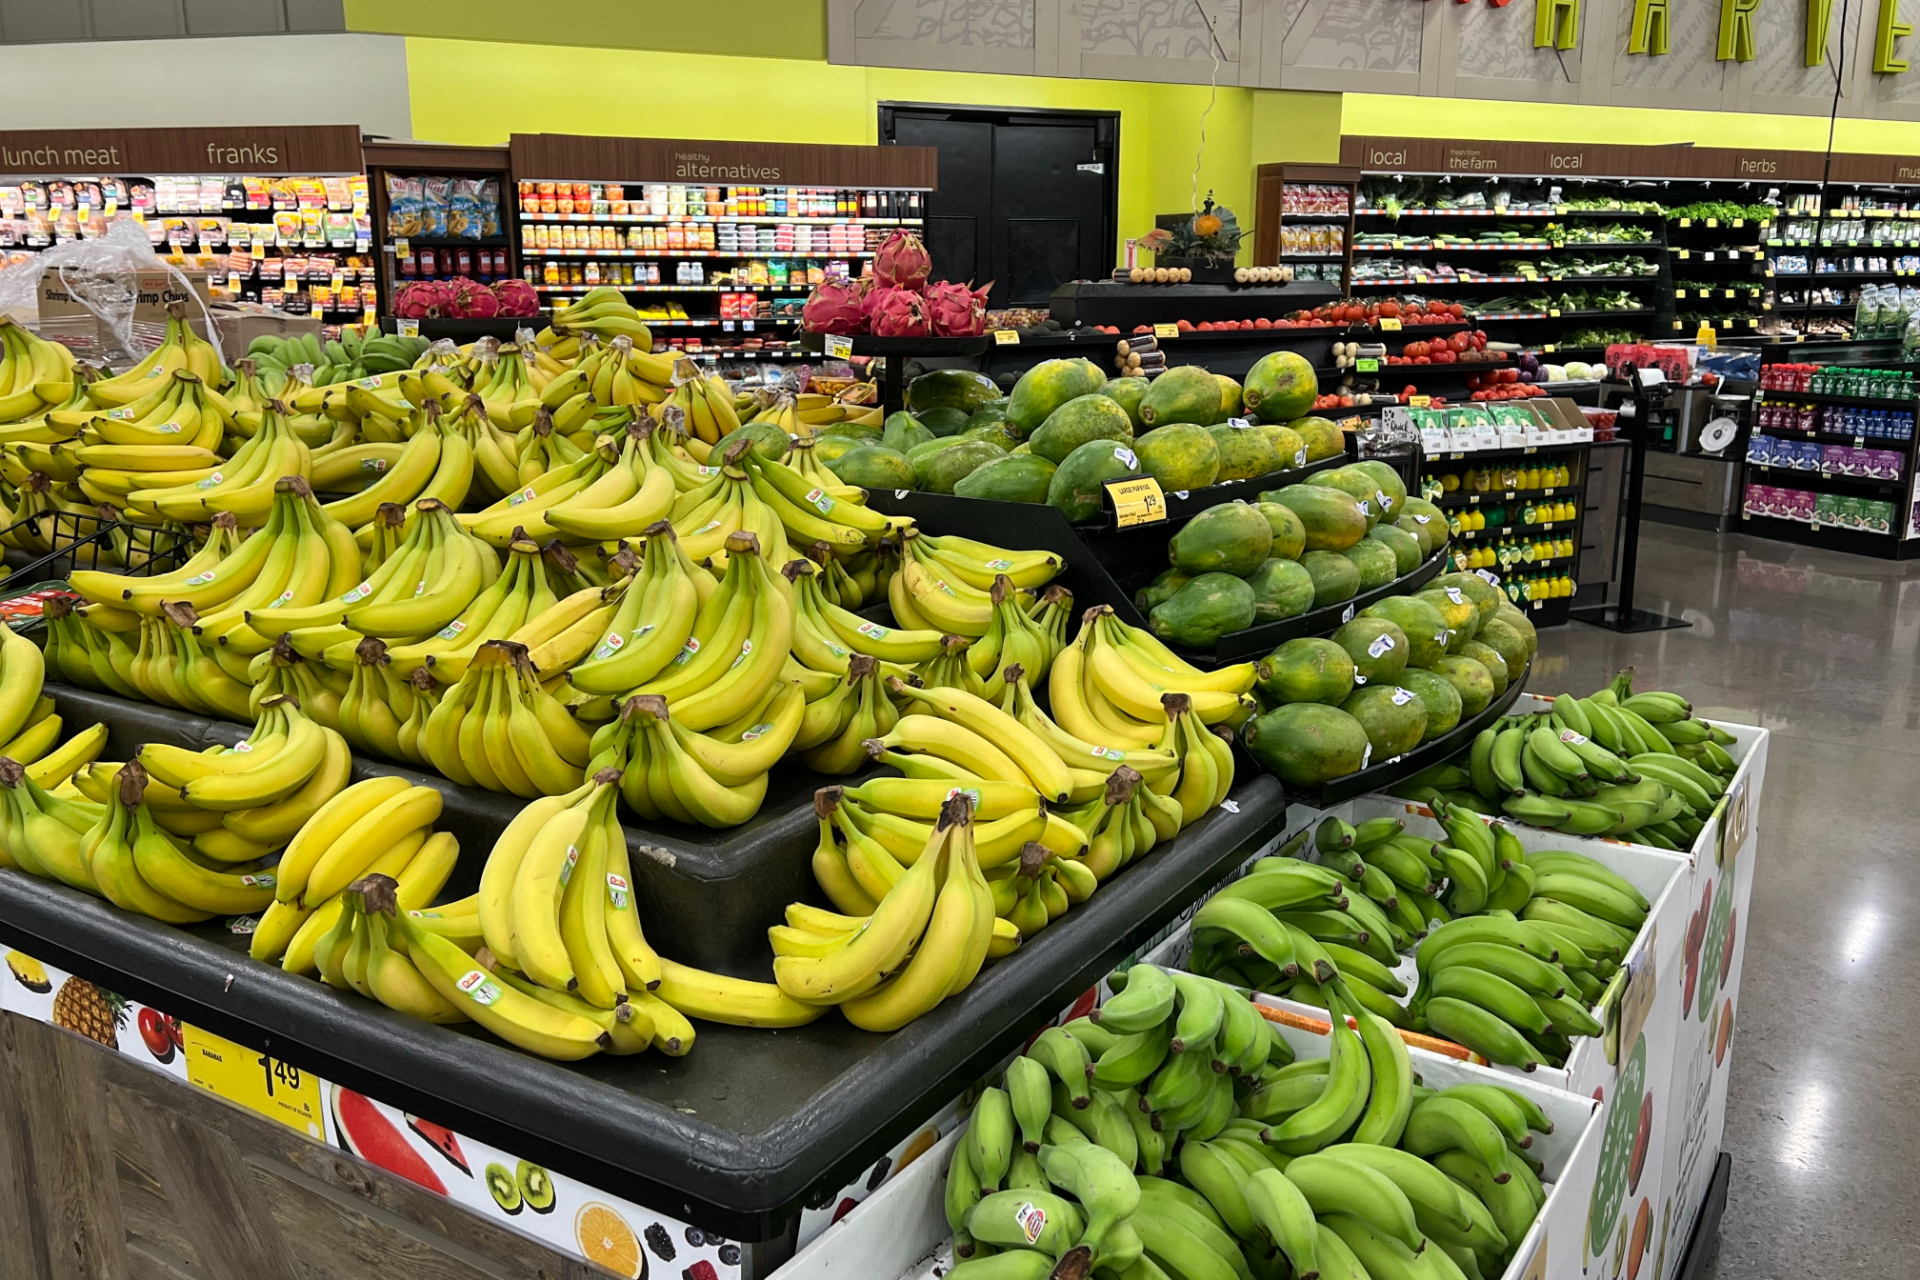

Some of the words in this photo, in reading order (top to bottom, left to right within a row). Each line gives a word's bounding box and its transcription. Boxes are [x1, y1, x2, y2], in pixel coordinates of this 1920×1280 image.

[3, 146, 59, 166] lunch
[64, 146, 120, 165] meat
[207, 143, 278, 164] franks
[675, 152, 710, 163] healthy
[1370, 148, 1407, 165] local
[1550, 153, 1583, 168] local
[676, 162, 780, 179] alternatives
[1449, 157, 1468, 169] the
[1470, 157, 1497, 169] farm
[1741, 157, 1777, 173] herbs
[610, 876, 626, 888] Dole
[461, 972, 481, 990] Dole
[202, 1048, 223, 1063] BANANAS
